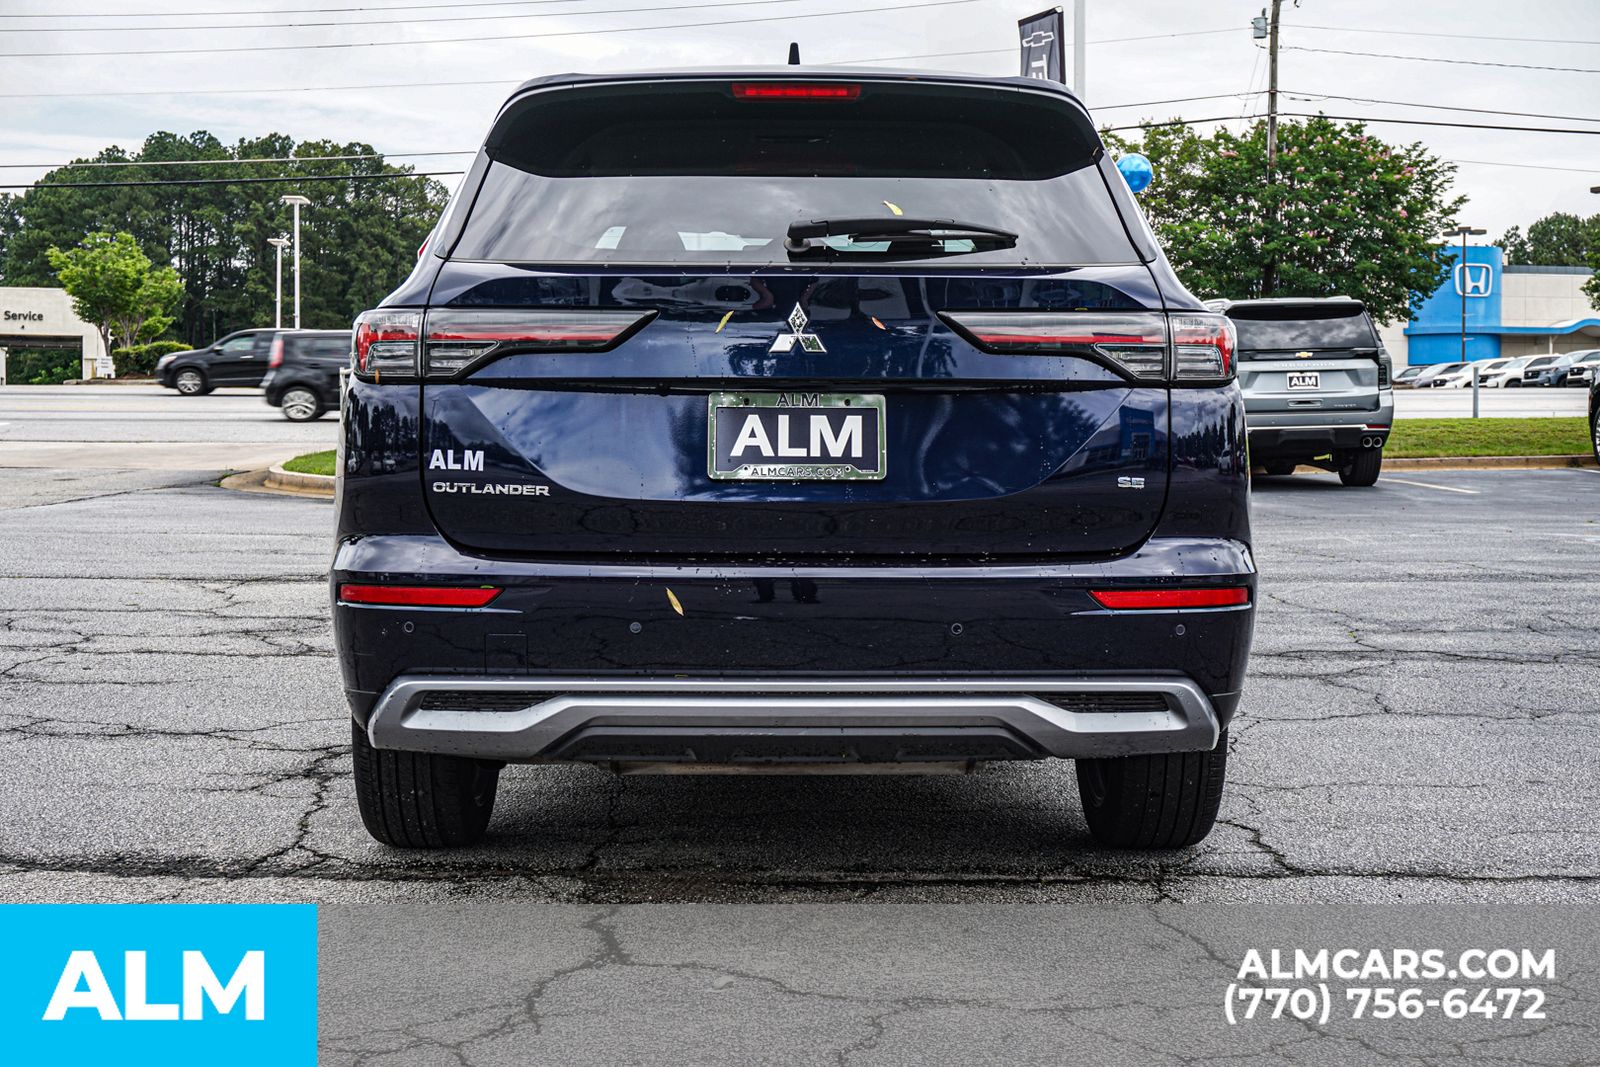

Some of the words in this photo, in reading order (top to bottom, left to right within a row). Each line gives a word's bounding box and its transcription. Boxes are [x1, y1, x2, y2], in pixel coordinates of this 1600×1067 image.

[3, 310, 44, 321] Service
[1291, 376, 1317, 387] ALM
[776, 393, 820, 407] ALM
[729, 414, 863, 458] ALM
[428, 449, 485, 472] ALM
[750, 467, 845, 478] ALMCARS.COM
[432, 481, 551, 497] OUTLANDER
[1117, 476, 1145, 489] SE
